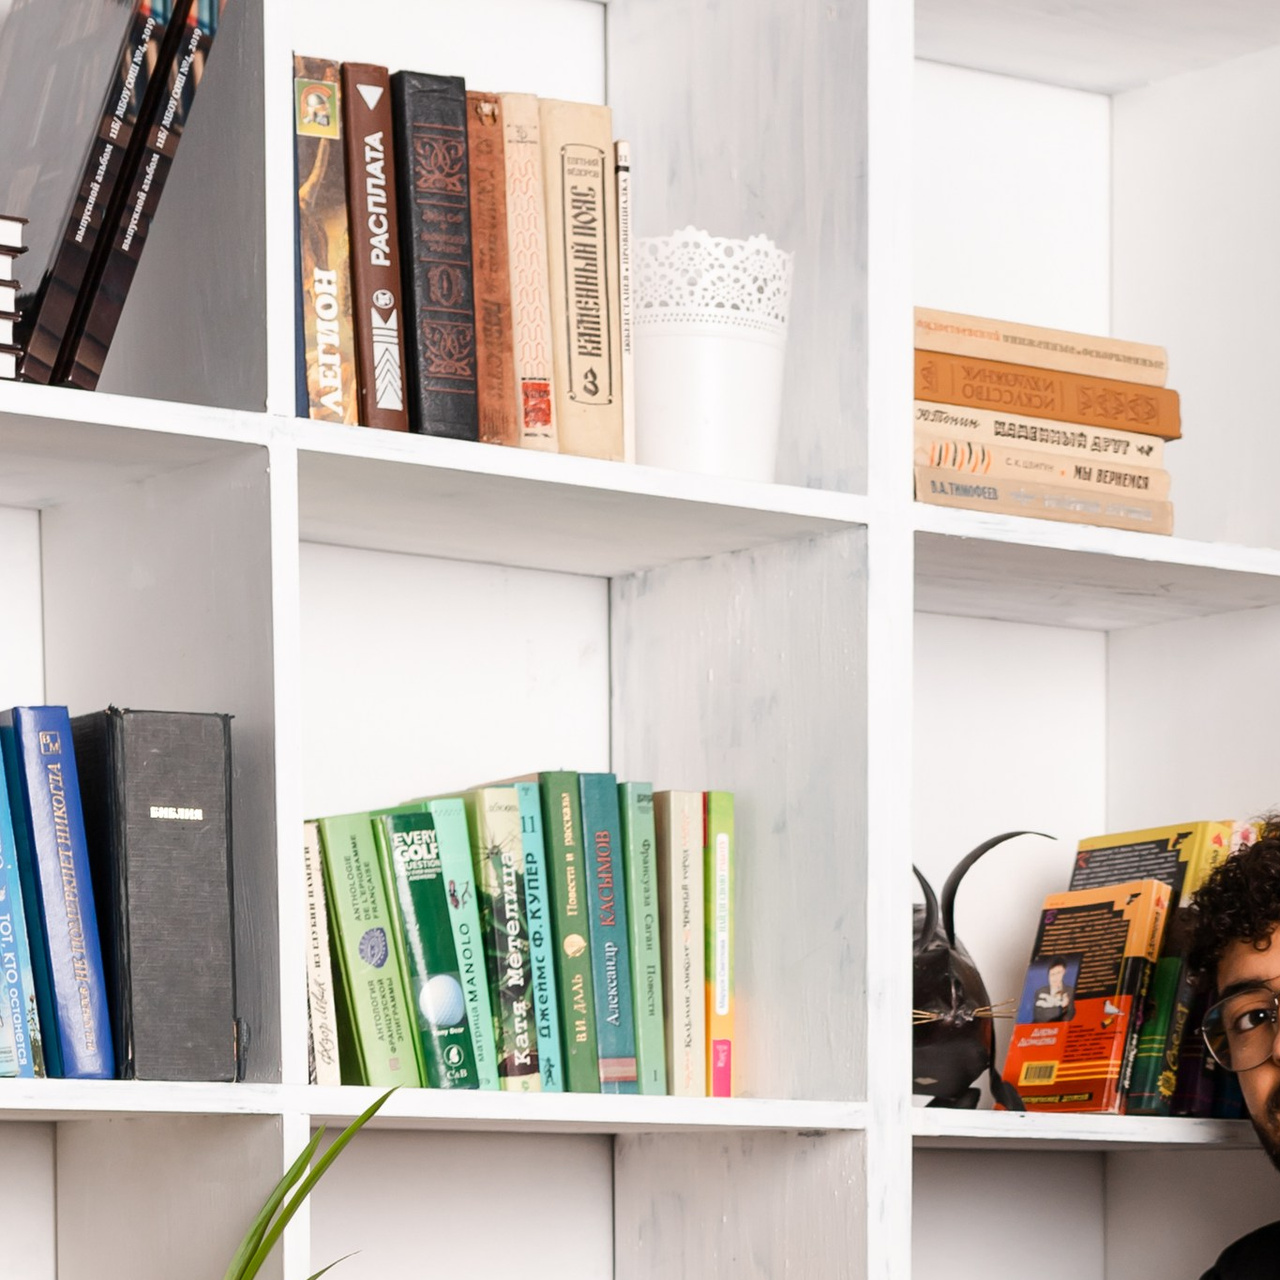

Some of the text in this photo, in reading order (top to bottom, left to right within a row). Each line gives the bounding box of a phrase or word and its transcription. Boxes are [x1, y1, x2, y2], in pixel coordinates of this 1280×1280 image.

[125, 64, 139, 92] СОШ
[141, 17, 156, 44] 2019
[171, 73, 187, 99] СОШ
[187, 28, 203, 55] 2019
[364, 131, 391, 267] РАСПЛАТА
[569, 185, 598, 238] ПОЯС
[572, 242, 603, 358] КАМЕННЫЙ
[313, 267, 344, 417] ЛЕГИОН
[1073, 464, 1151, 490] МЫ ВЕРНЕМСЯ
[47, 762, 74, 855] НИКОГДА
[150, 806, 203, 821] БИБЛИЯ
[394, 828, 437, 847] EVERY
[560, 792, 573, 847] рассказы
[396, 842, 441, 863] GOLF
[524, 851, 543, 921] КУПЕР
[566, 865, 578, 917] Повести
[500, 851, 532, 1067] Катя Метелица
[594, 829, 621, 1028] Александр КАСЫМОВ
[641, 838, 657, 1018] Франсуаза Саган Повести
[4, 950, 19, 985] КТО
[456, 922, 486, 1064] матрица MANOLO
[532, 953, 552, 1039] Джеймс
[571, 973, 585, 1013] ДАЛЬ
[8, 987, 29, 1068] останется
[368, 979, 385, 1042] АНТОЛОГИЯ
